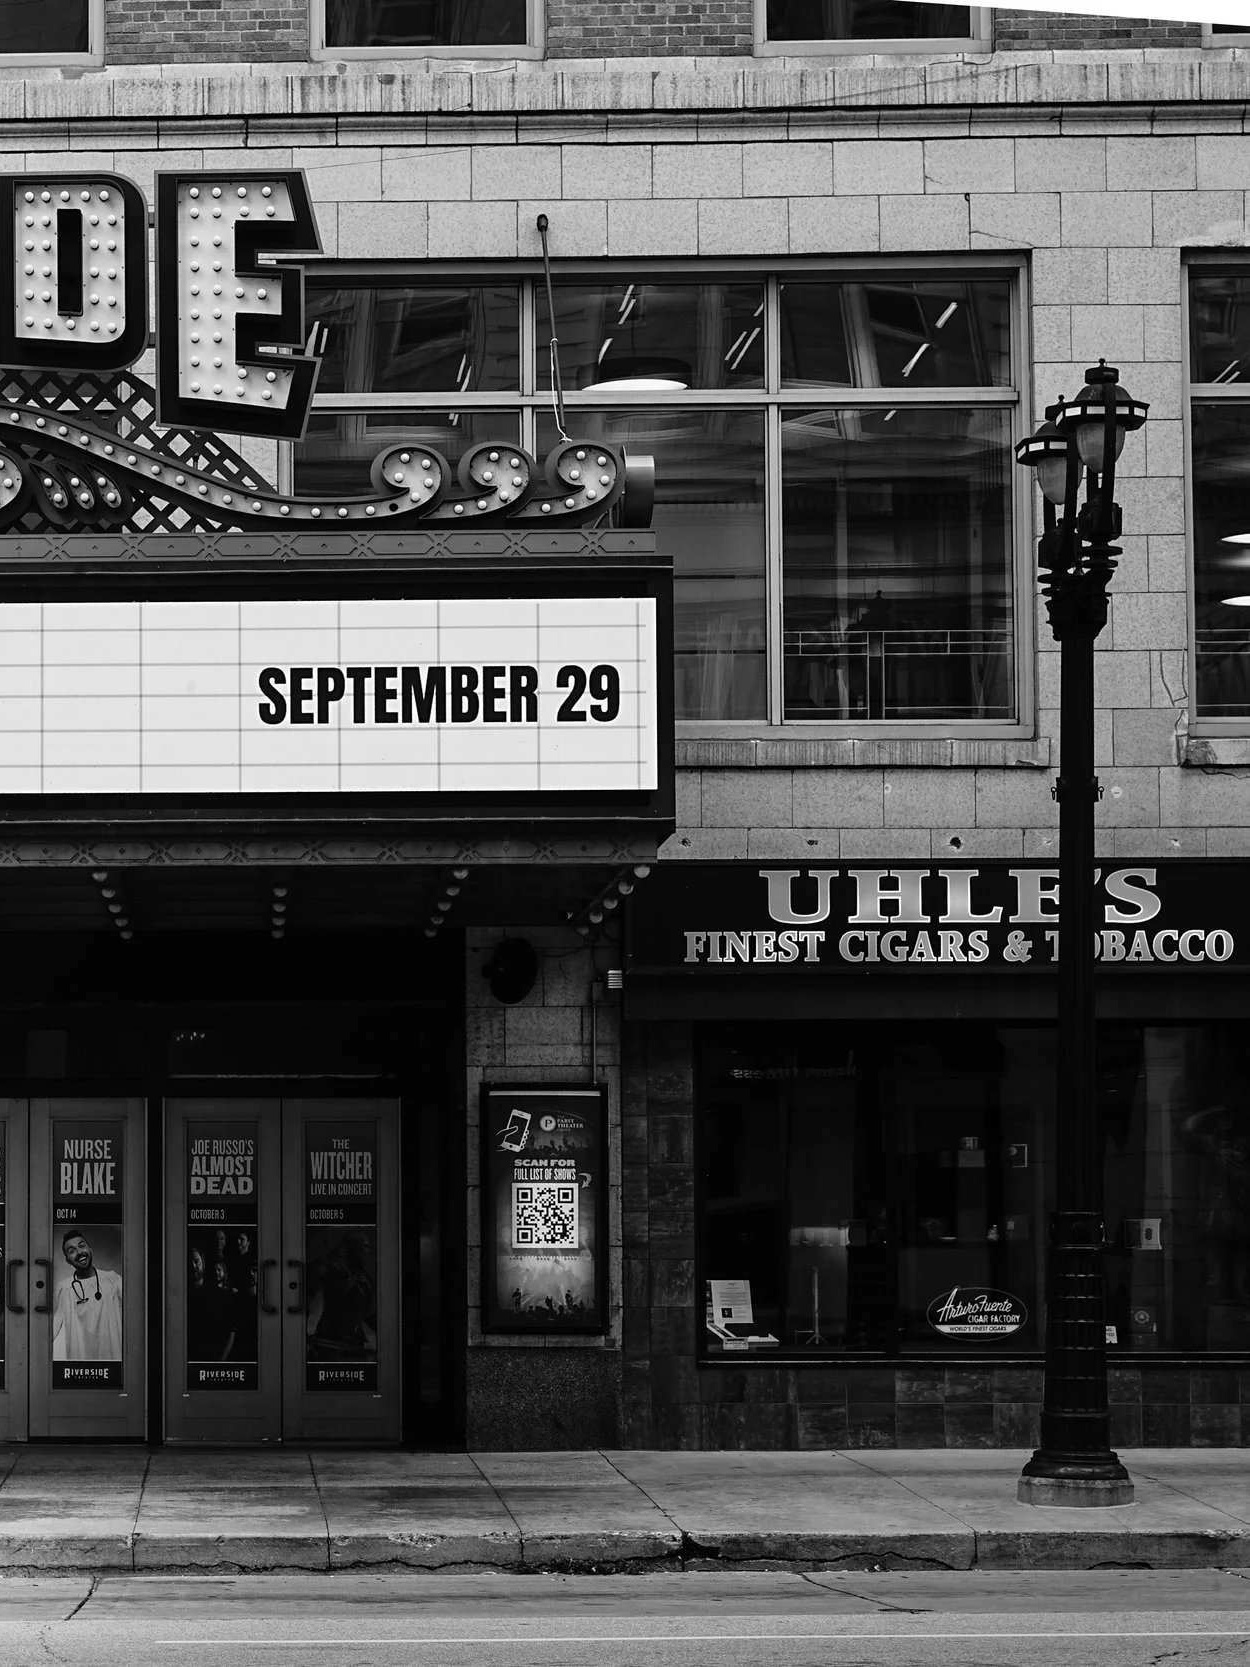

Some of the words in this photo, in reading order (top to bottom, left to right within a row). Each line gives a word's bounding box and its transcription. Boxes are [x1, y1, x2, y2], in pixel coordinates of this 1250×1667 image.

[258, 665, 538, 724] SEPTEMBER
[556, 664, 620, 722] 29
[684, 930, 825, 962] FINEST
[839, 930, 990, 962] CIGARS
[1003, 930, 1032, 963] &
[1045, 930, 1234, 962] BACCO
[64, 1140, 112, 1159] NURSE
[192, 1140, 210, 1155] JOE
[213, 1140, 254, 1155] RUSSO'S
[332, 1139, 350, 1149] THE
[191, 1156, 254, 1176] ALMOST
[310, 1152, 373, 1180] WITCHER
[514, 1159, 548, 1167] SCAN
[550, 1159, 575, 1167] FOR
[60, 1162, 115, 1195] BLAKE
[514, 1168, 529, 1180] FULL
[530, 1168, 543, 1180] LIST
[545, 1168, 553, 1180] OF
[554, 1168, 576, 1180] SHOWS
[191, 1177, 253, 1195] DEAD
[310, 1184, 327, 1195] LIVE
[328, 1184, 336, 1195] IN
[338, 1184, 372, 1195] CONCERT
[56, 1209, 69, 1219] OCT
[69, 1209, 76, 1219] 14
[191, 1209, 219, 1219] OCTOBER
[220, 1209, 225, 1219] 3
[310, 1210, 338, 1220] OCTOBER
[340, 1210, 344, 1220] 5
[937, 1288, 979, 1322] Arturo
[975, 1295, 1012, 1312] Fuente
[968, 1315, 988, 1323] CIGAR
[991, 1315, 1020, 1323] FACTORY
[64, 1367, 109, 1379] RIVERSIDE
[200, 1370, 245, 1381] RIVERSIDE
[319, 1370, 364, 1381] RIVERSIDE
